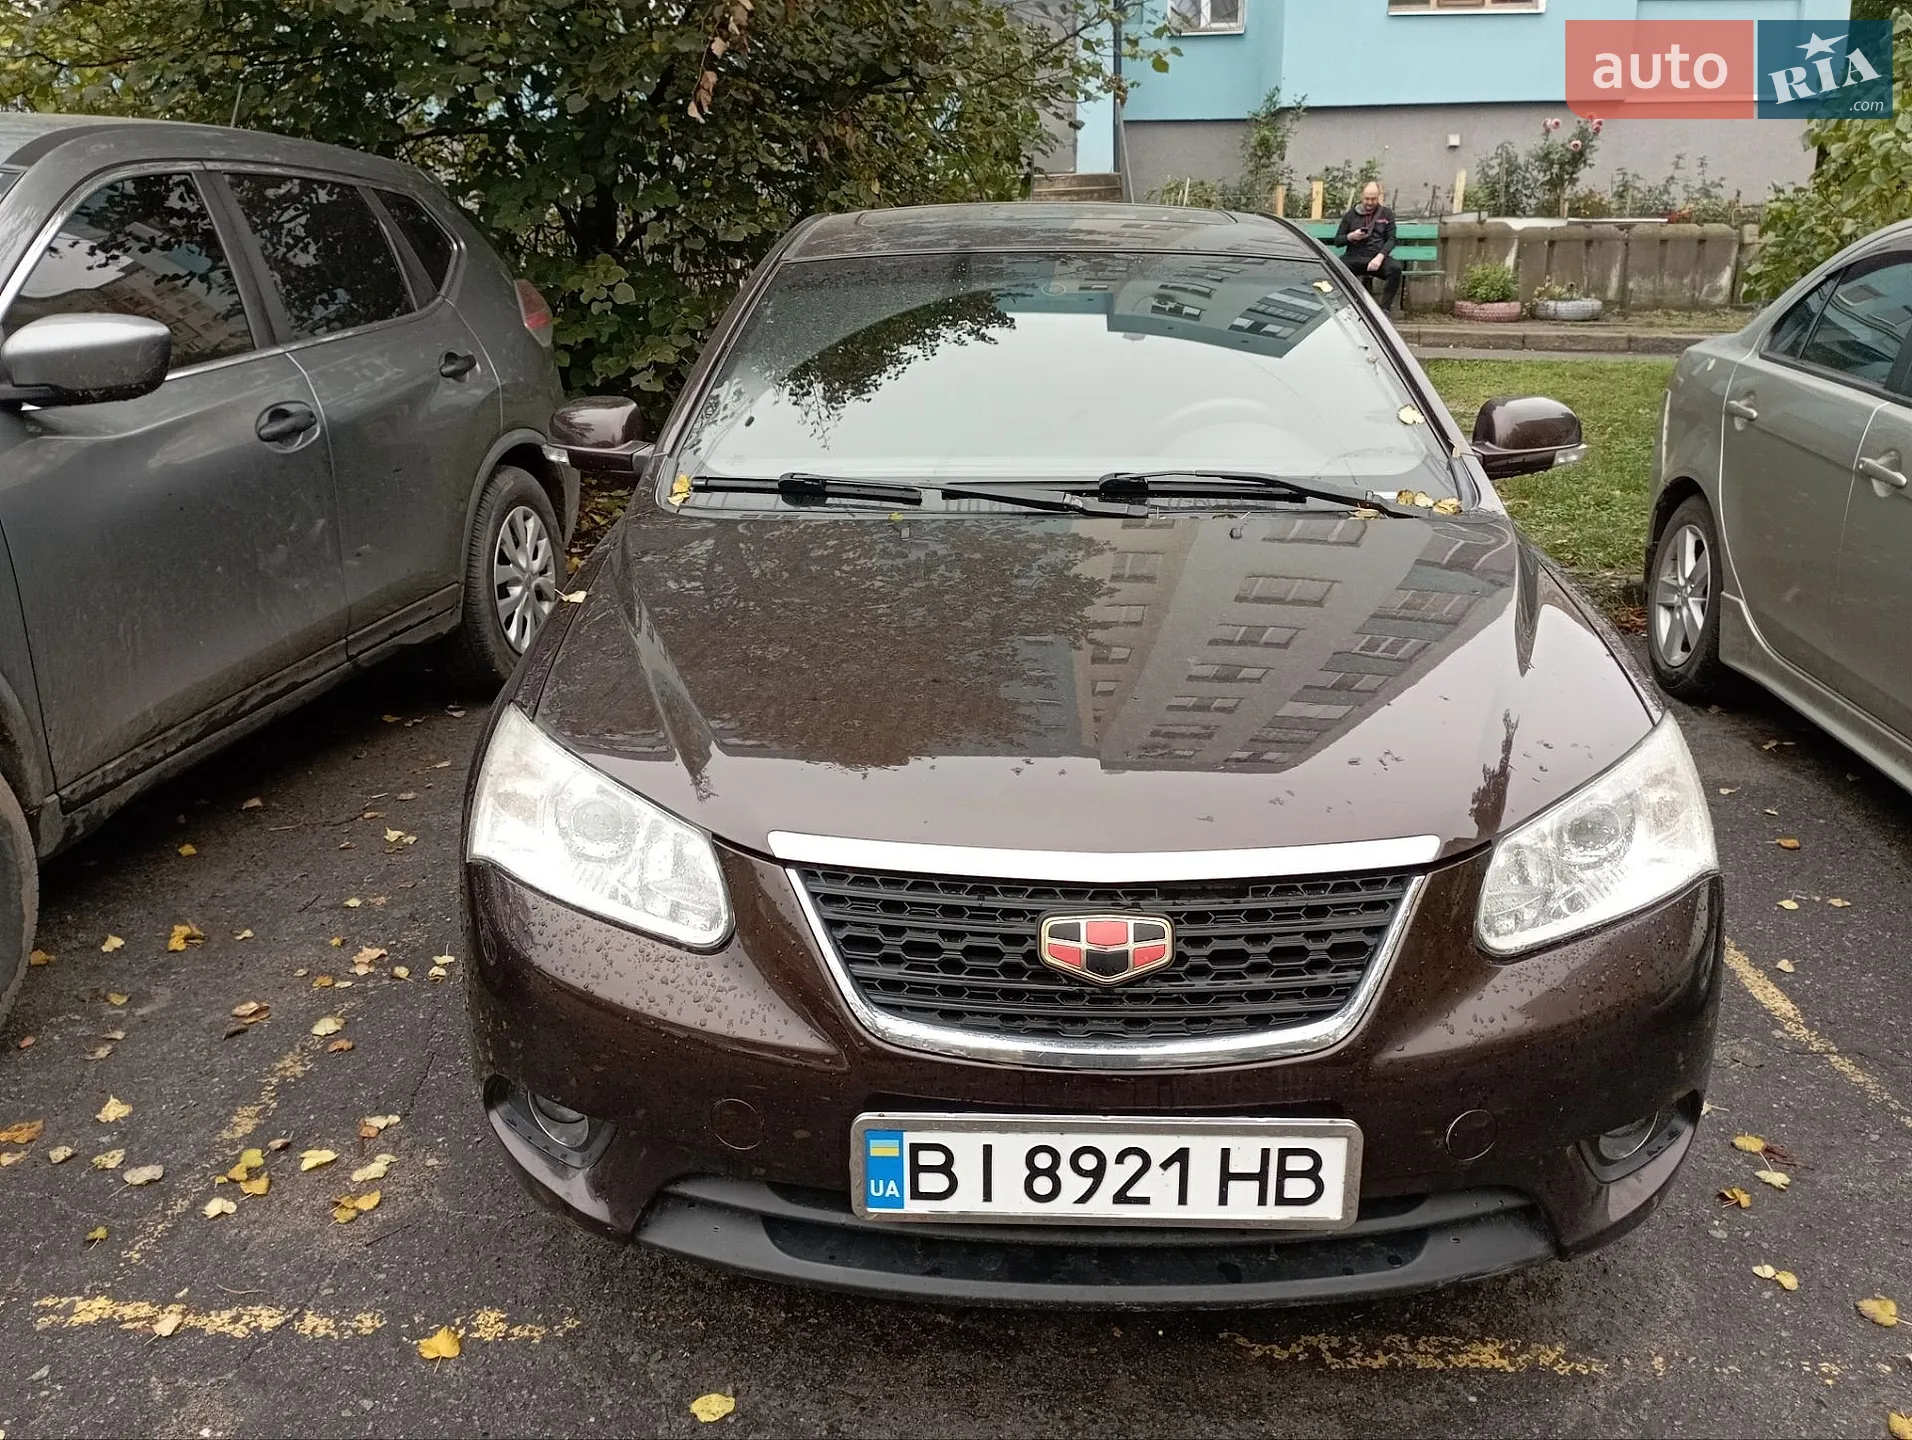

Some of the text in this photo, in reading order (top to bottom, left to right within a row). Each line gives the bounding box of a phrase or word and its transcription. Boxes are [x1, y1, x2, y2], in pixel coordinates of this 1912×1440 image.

[869, 1179, 900, 1197] UA
[908, 1142, 1325, 1207] BI 8921 HB
